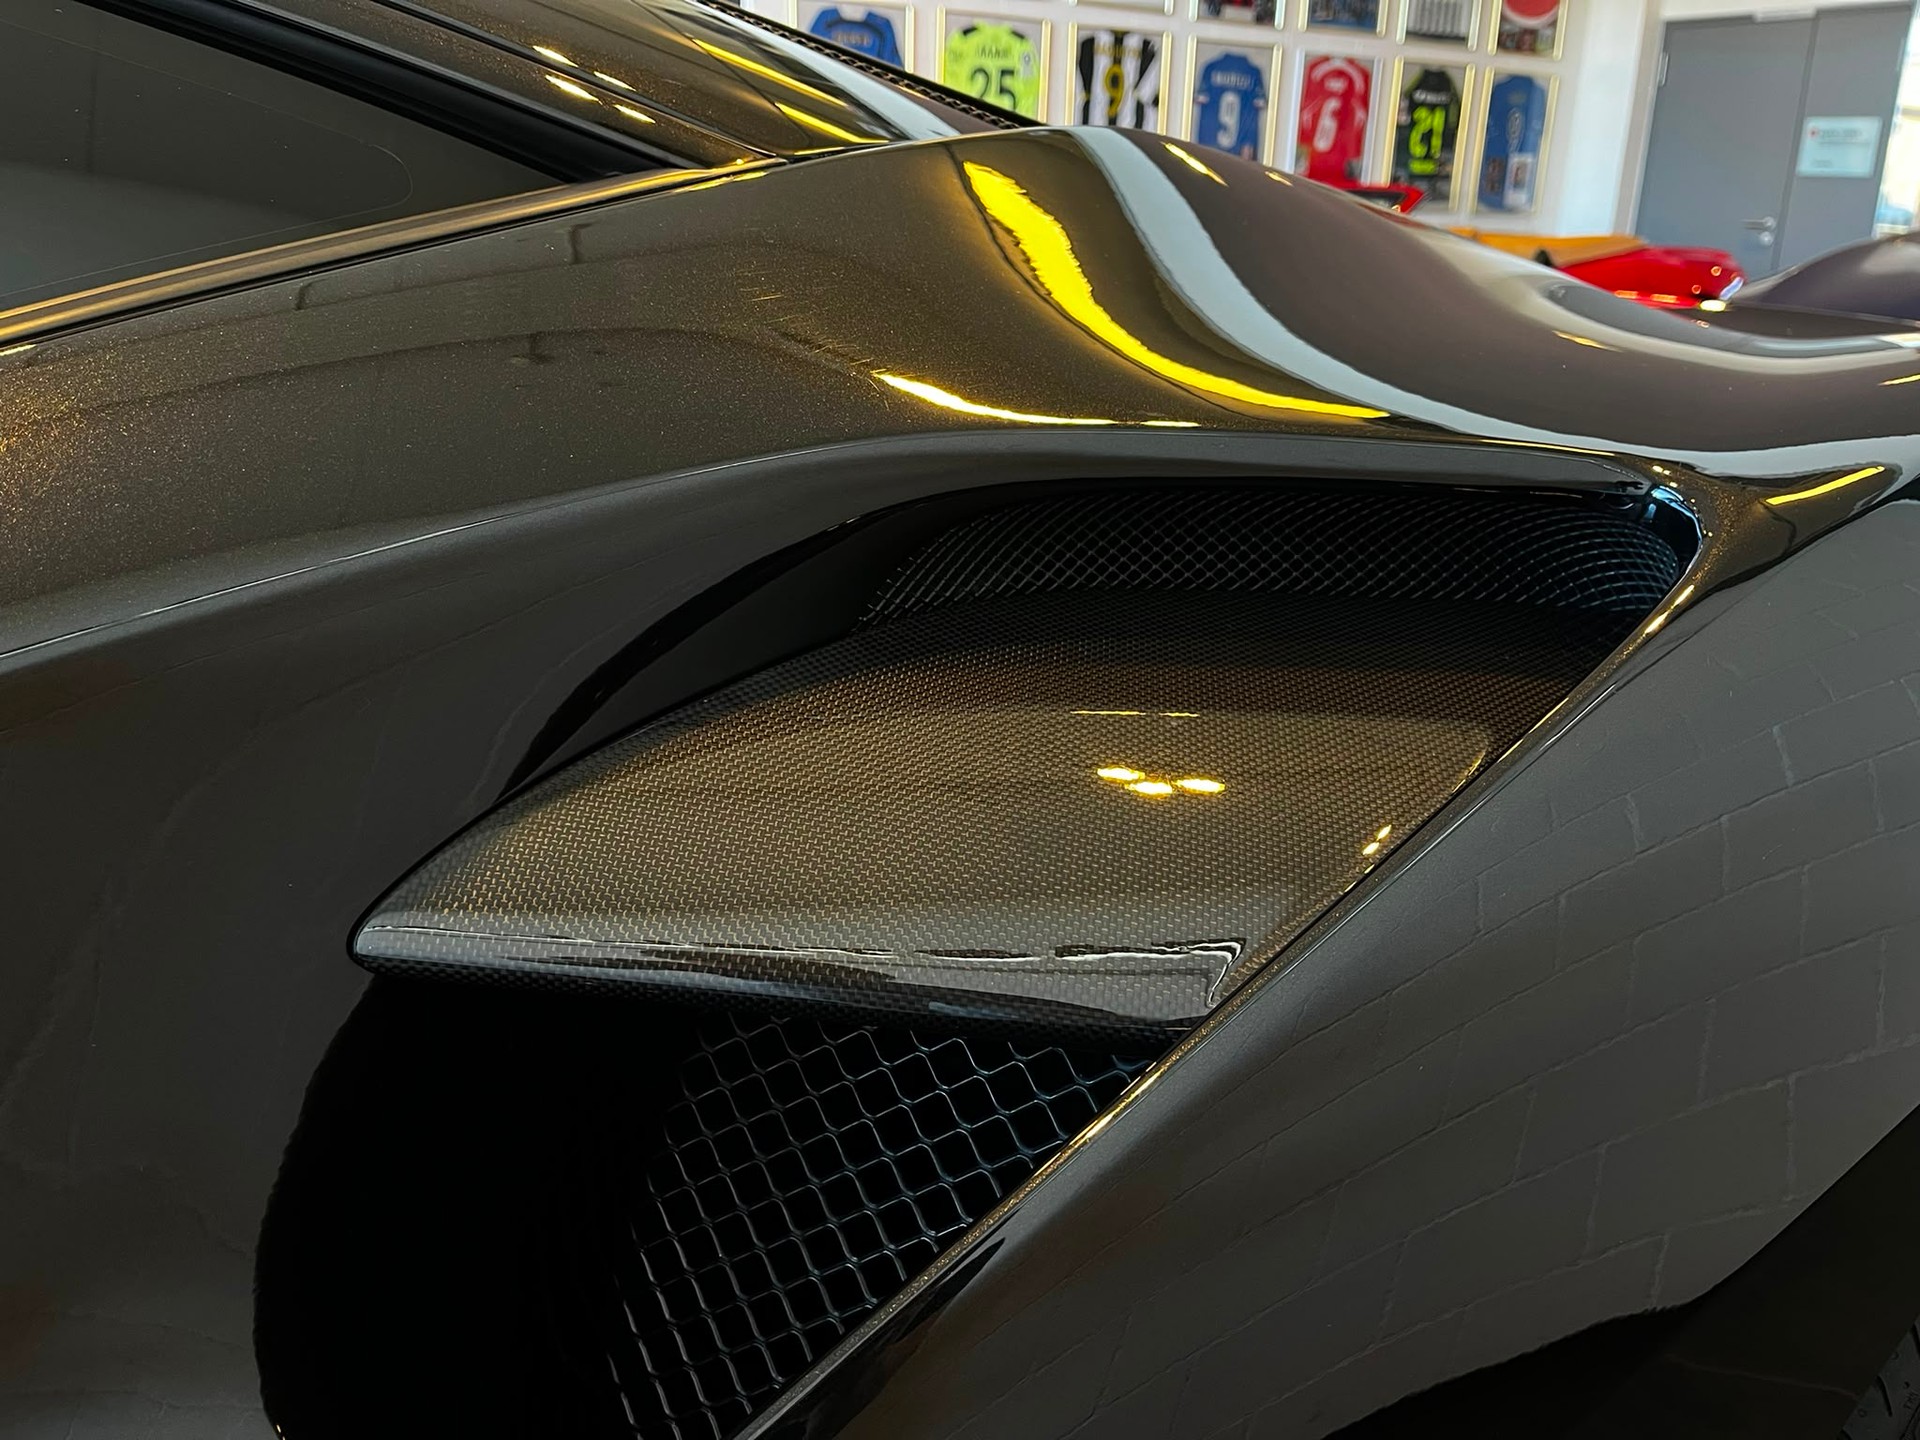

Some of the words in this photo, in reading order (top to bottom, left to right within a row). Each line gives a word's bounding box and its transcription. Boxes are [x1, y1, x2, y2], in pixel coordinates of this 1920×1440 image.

[970, 67, 1016, 111] 25
[1104, 63, 1125, 117] 9
[1217, 91, 1241, 149] 9
[1313, 96, 1339, 153] 6
[1408, 105, 1446, 159] 21
